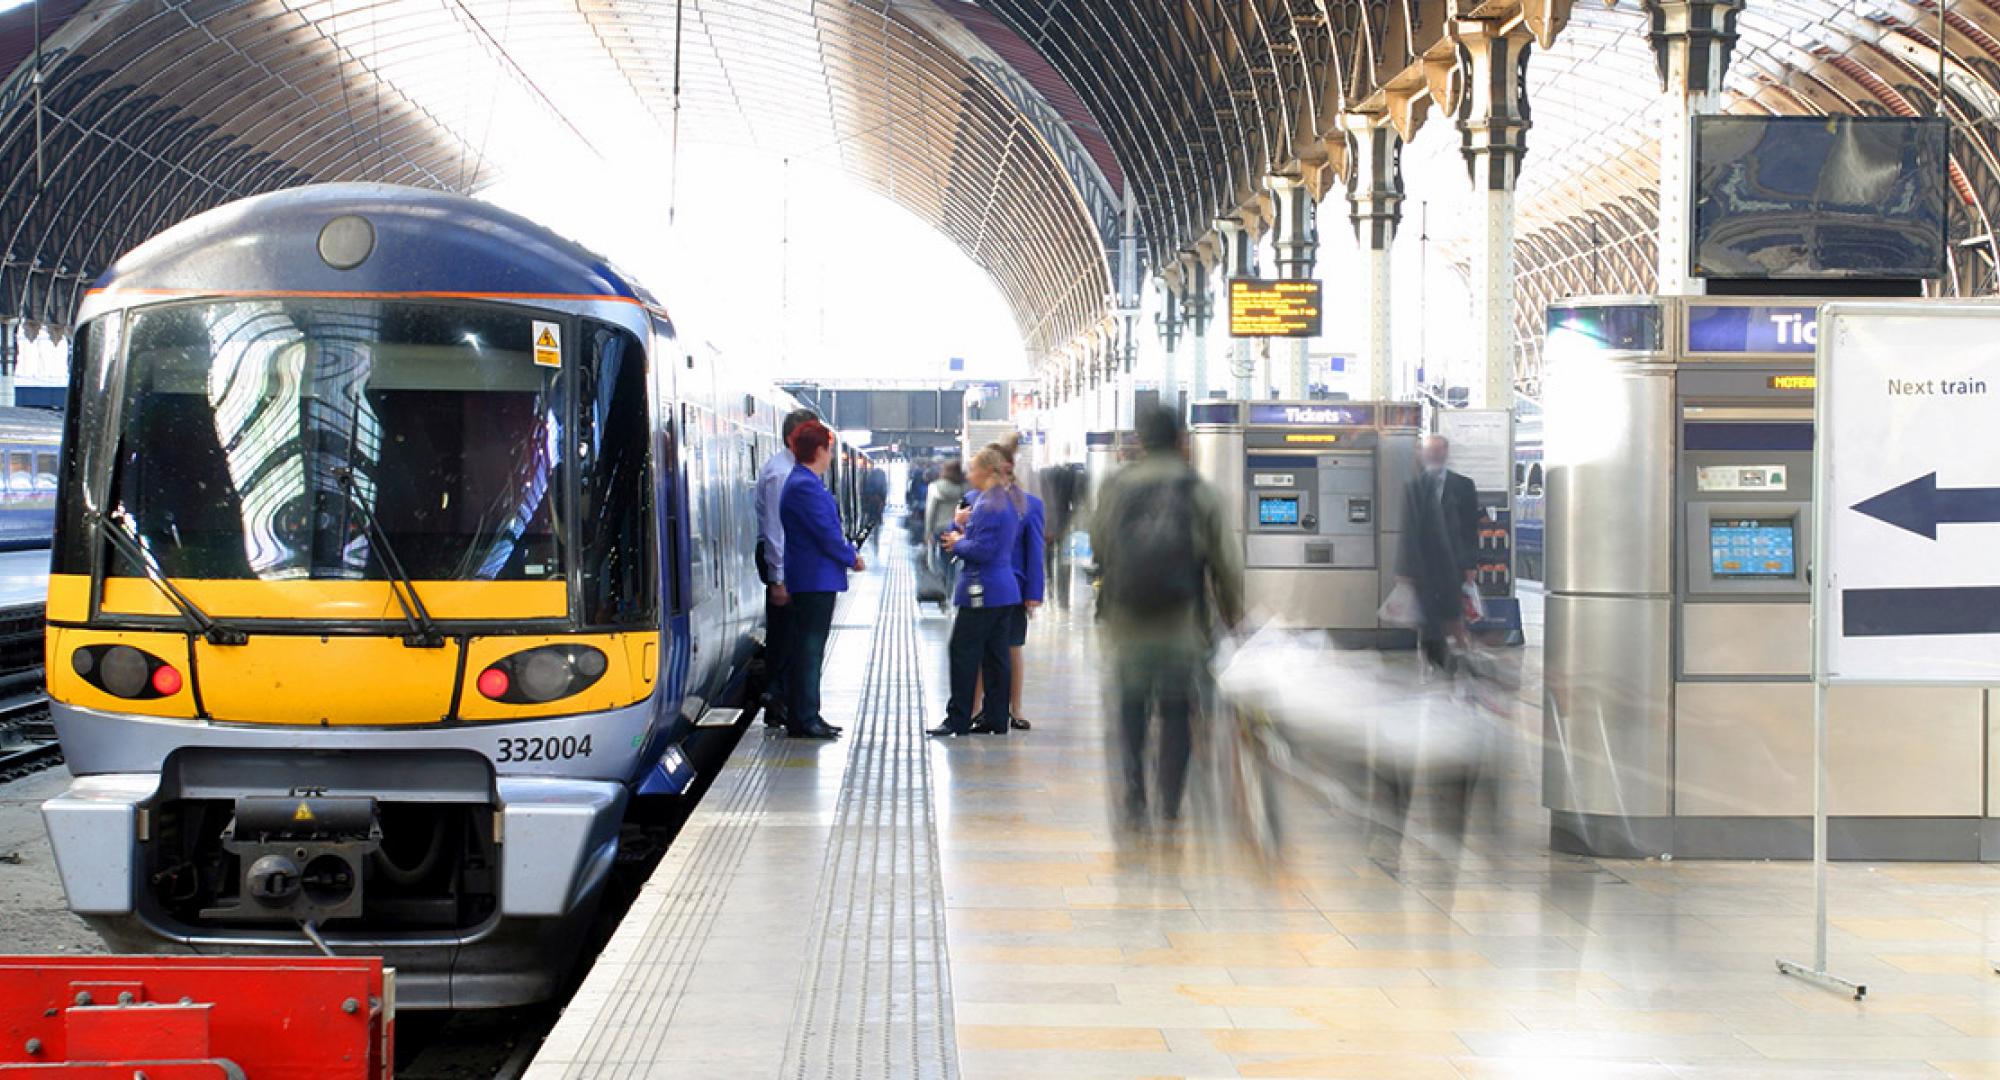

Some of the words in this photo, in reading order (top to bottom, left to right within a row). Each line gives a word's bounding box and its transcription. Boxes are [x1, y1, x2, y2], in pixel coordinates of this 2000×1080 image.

[1770, 313, 1817, 345] Tic
[1888, 379, 1934, 395] Next
[1941, 376, 1986, 395] train
[1285, 407, 1339, 422] Tickets
[496, 734, 593, 762] 332004
